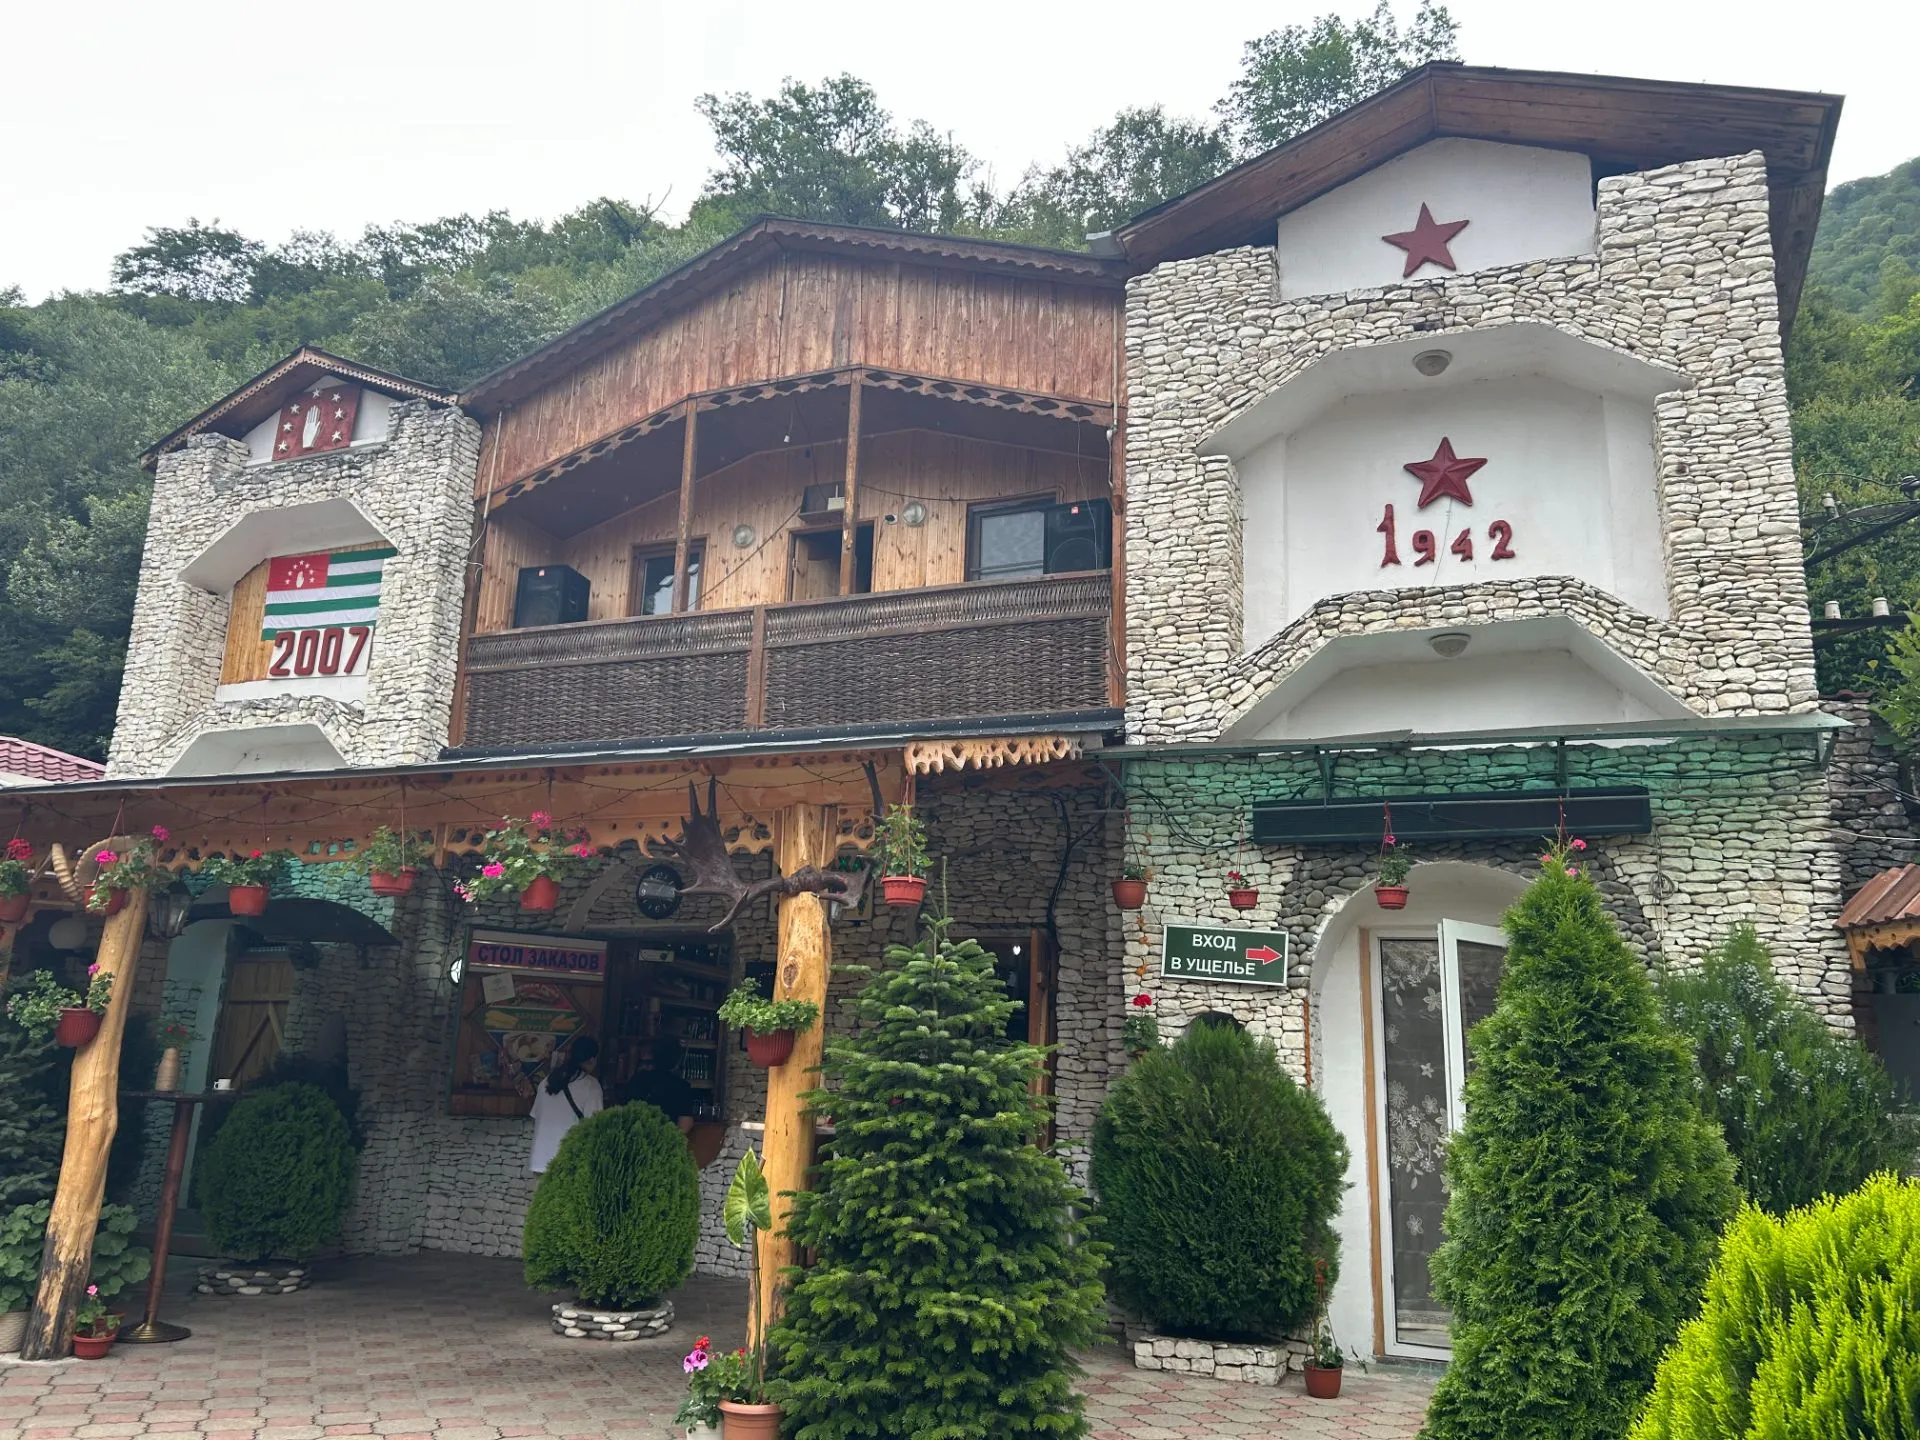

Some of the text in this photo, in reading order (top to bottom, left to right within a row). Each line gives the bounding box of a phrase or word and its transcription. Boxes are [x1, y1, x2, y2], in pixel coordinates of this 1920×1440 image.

[1377, 503, 1515, 568] 1942
[269, 626, 370, 677] 2007
[1192, 934, 1236, 952] ВХОД
[478, 944, 600, 970] СТОЛ ЗАКАЗОВ
[1171, 957, 1256, 976] В УЩЕЛЬЕ
